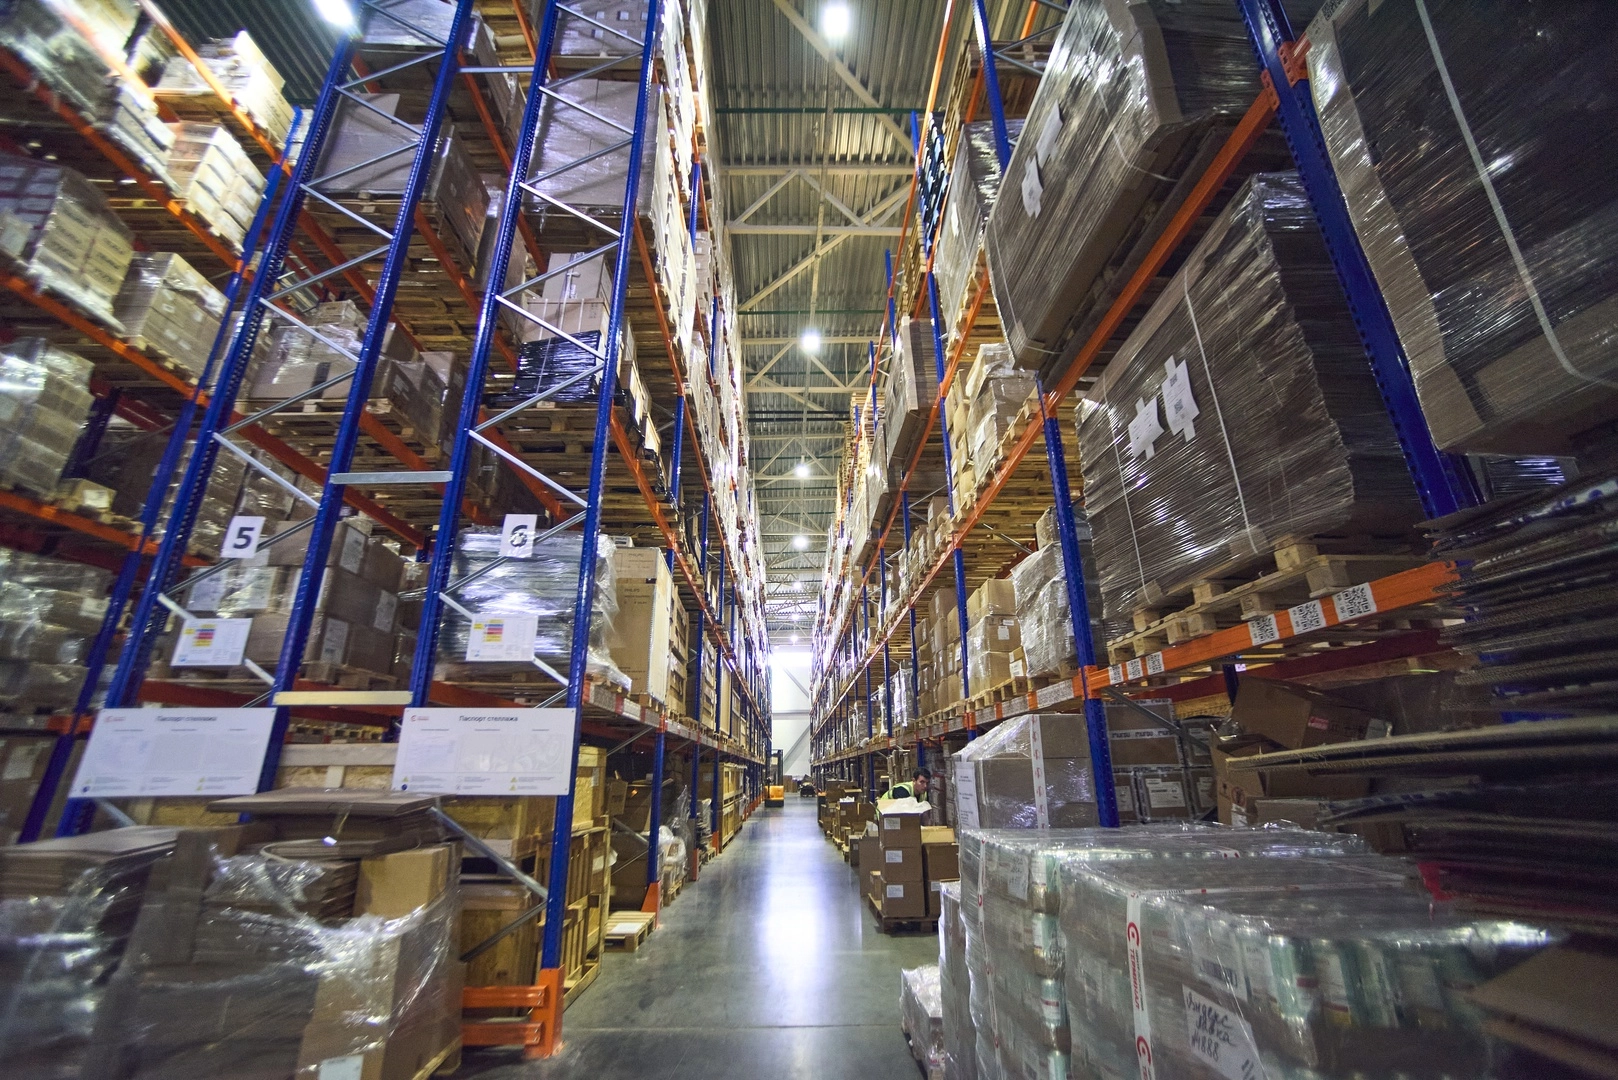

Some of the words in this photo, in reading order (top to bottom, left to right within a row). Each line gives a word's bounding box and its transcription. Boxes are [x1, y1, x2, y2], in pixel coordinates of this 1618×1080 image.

[232, 526, 256, 550] 5
[510, 524, 529, 548] 6
[458, 715, 486, 723] Паспорт
